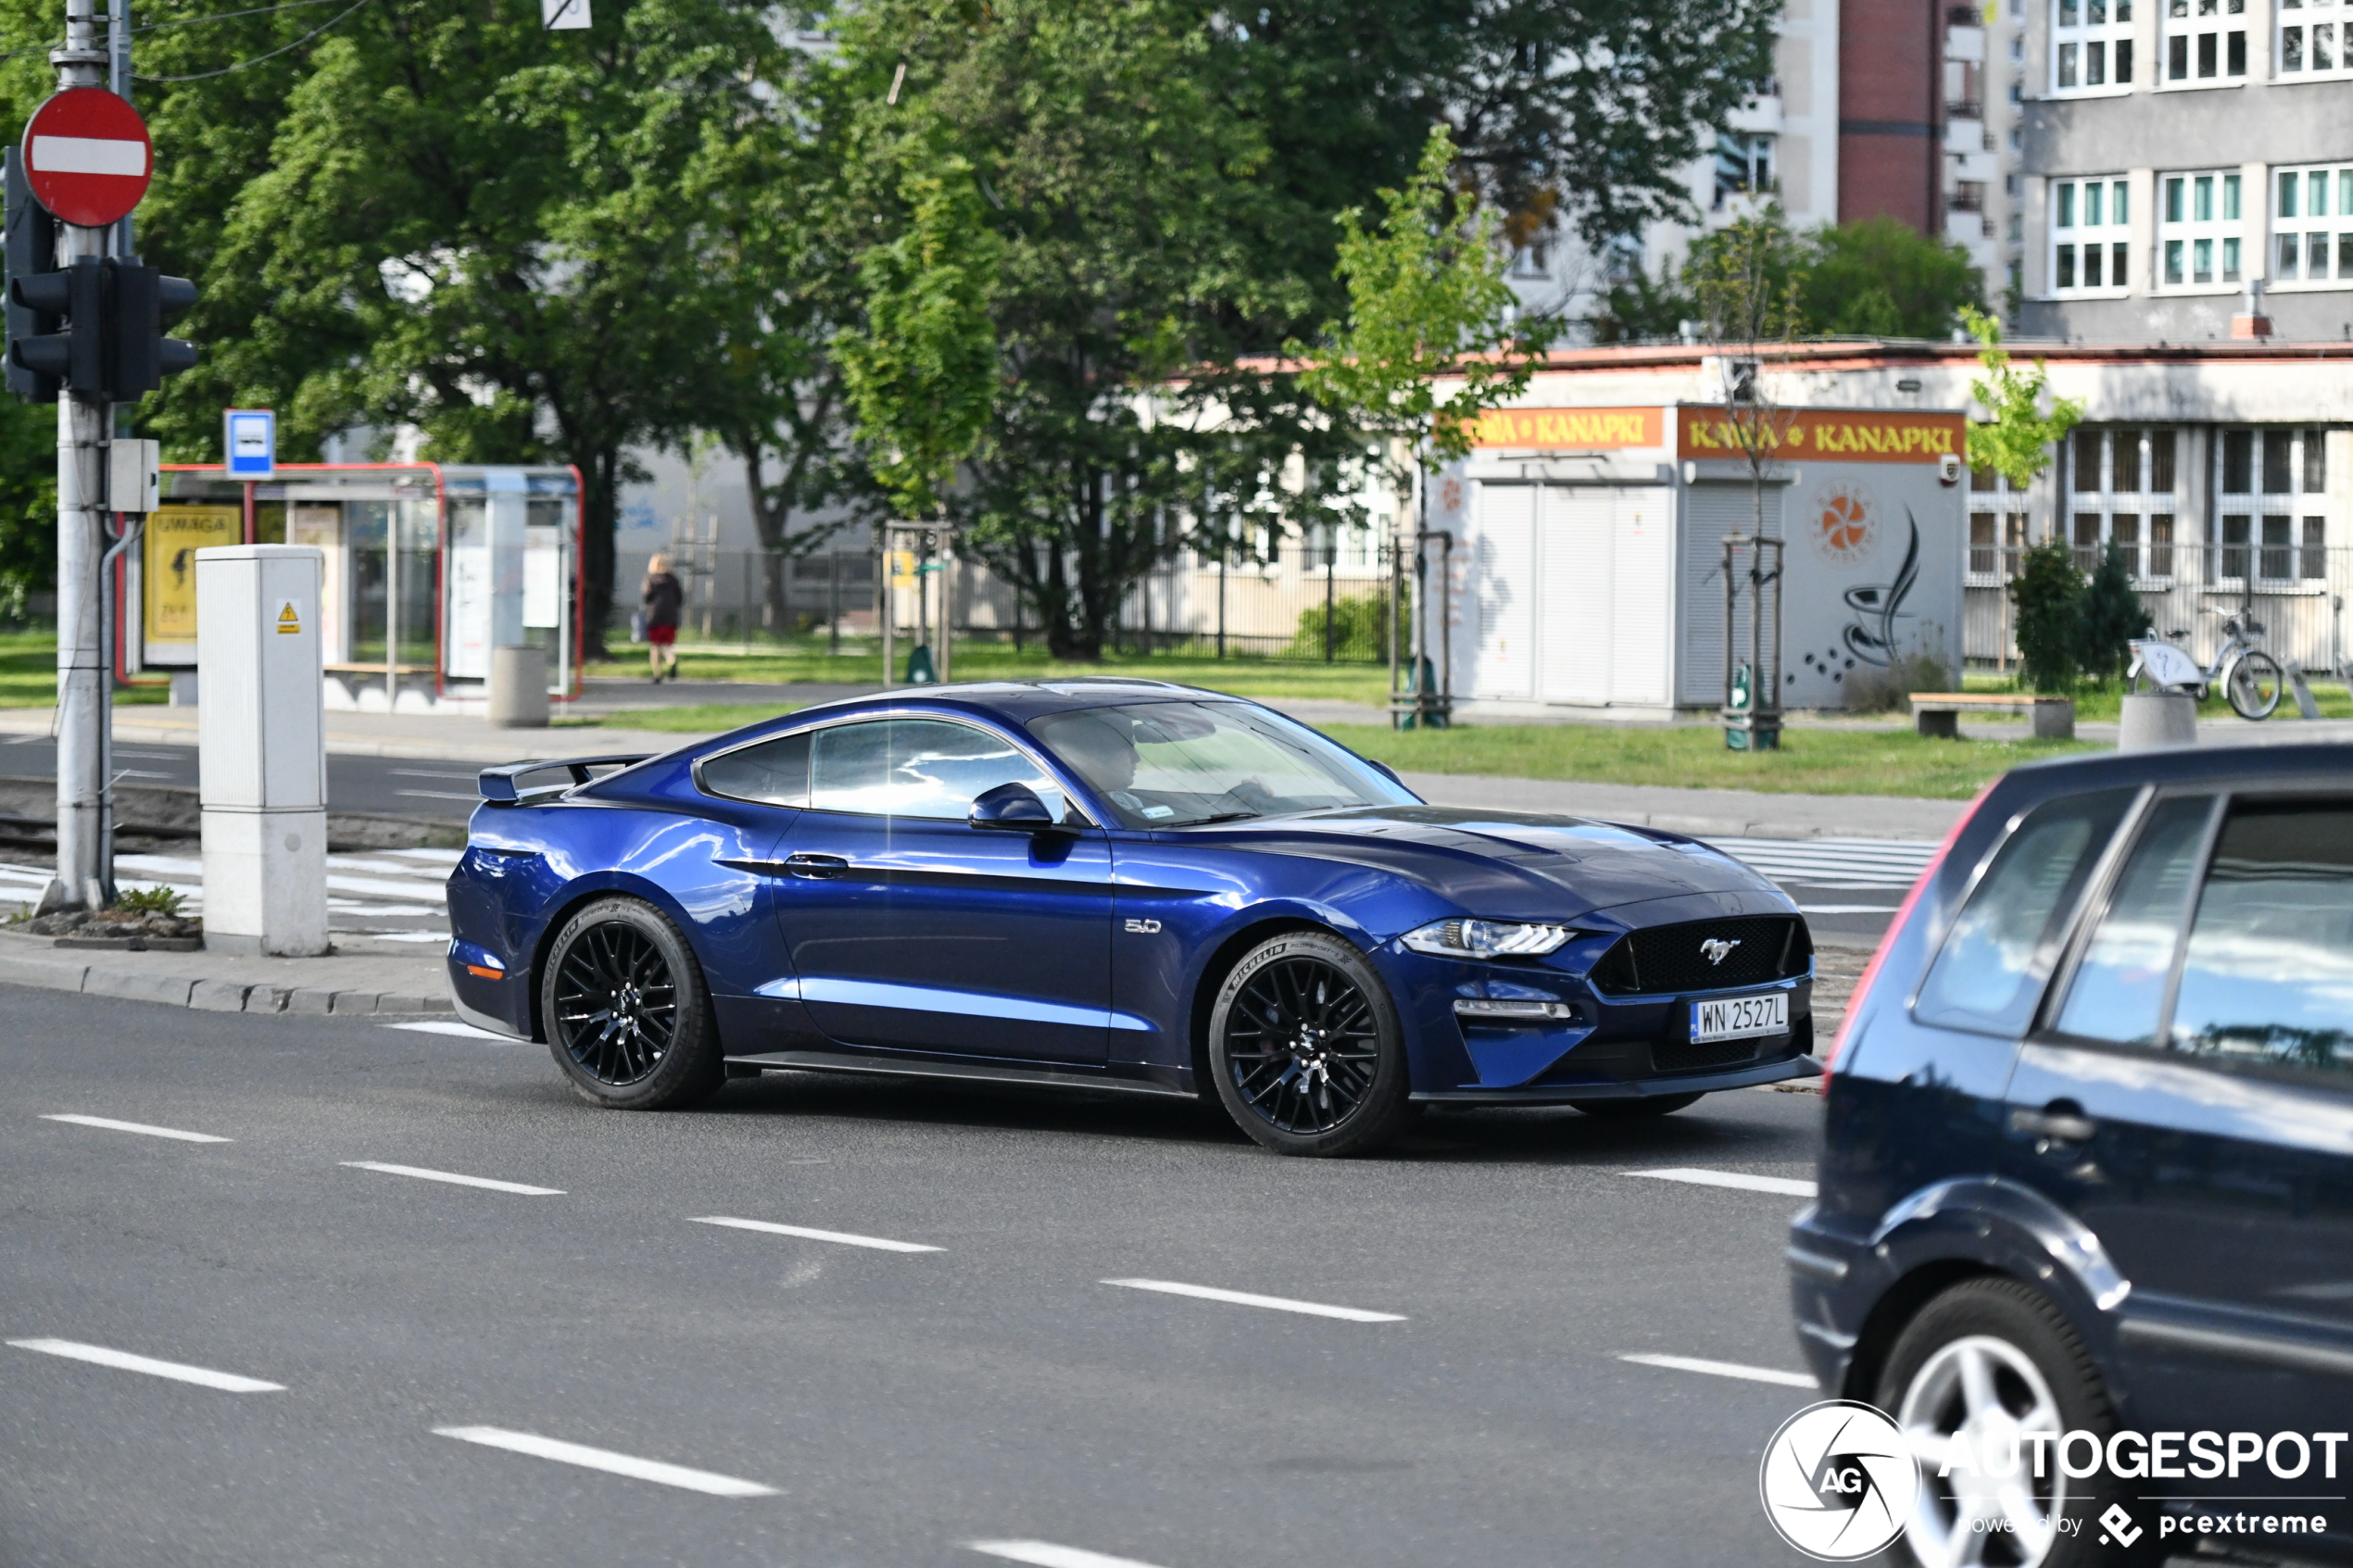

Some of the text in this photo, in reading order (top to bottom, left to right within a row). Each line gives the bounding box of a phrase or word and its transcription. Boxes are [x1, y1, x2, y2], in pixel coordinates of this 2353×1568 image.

[1537, 414, 1644, 444] KANAPKI
[1689, 420, 1954, 454] KAWA KANAPKI
[156, 516, 226, 533] UWAGA
[1124, 918, 1162, 934] 5.0
[545, 916, 578, 982] MICHELIN
[1309, 943, 1331, 954] SPORT
[1231, 943, 1284, 988] MICHELIN
[1691, 1023, 1698, 1033] PL
[1702, 997, 1784, 1034] WN 2527L
